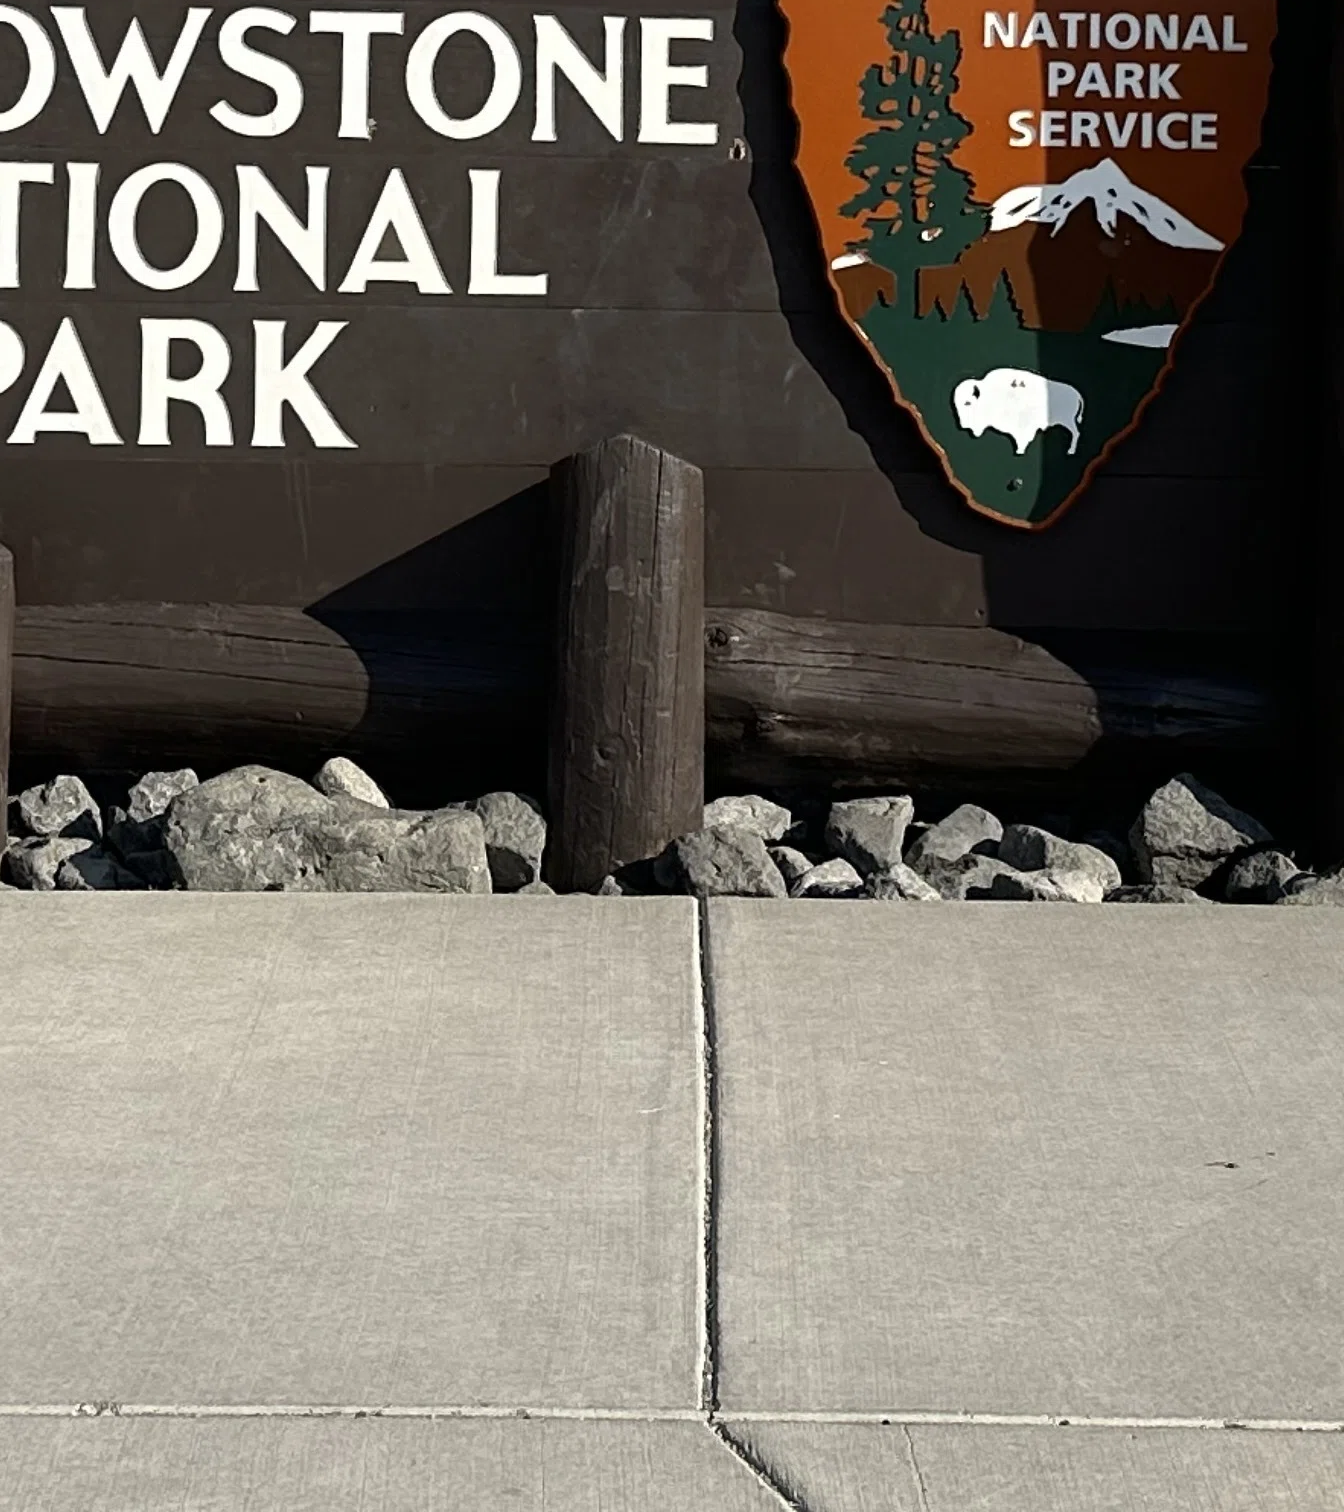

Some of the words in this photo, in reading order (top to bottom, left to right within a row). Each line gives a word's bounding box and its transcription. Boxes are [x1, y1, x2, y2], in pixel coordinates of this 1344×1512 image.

[982, 10, 1248, 52] NATIONAL
[1047, 61, 1181, 100] PARK
[1008, 109, 1218, 150] SERVICE
